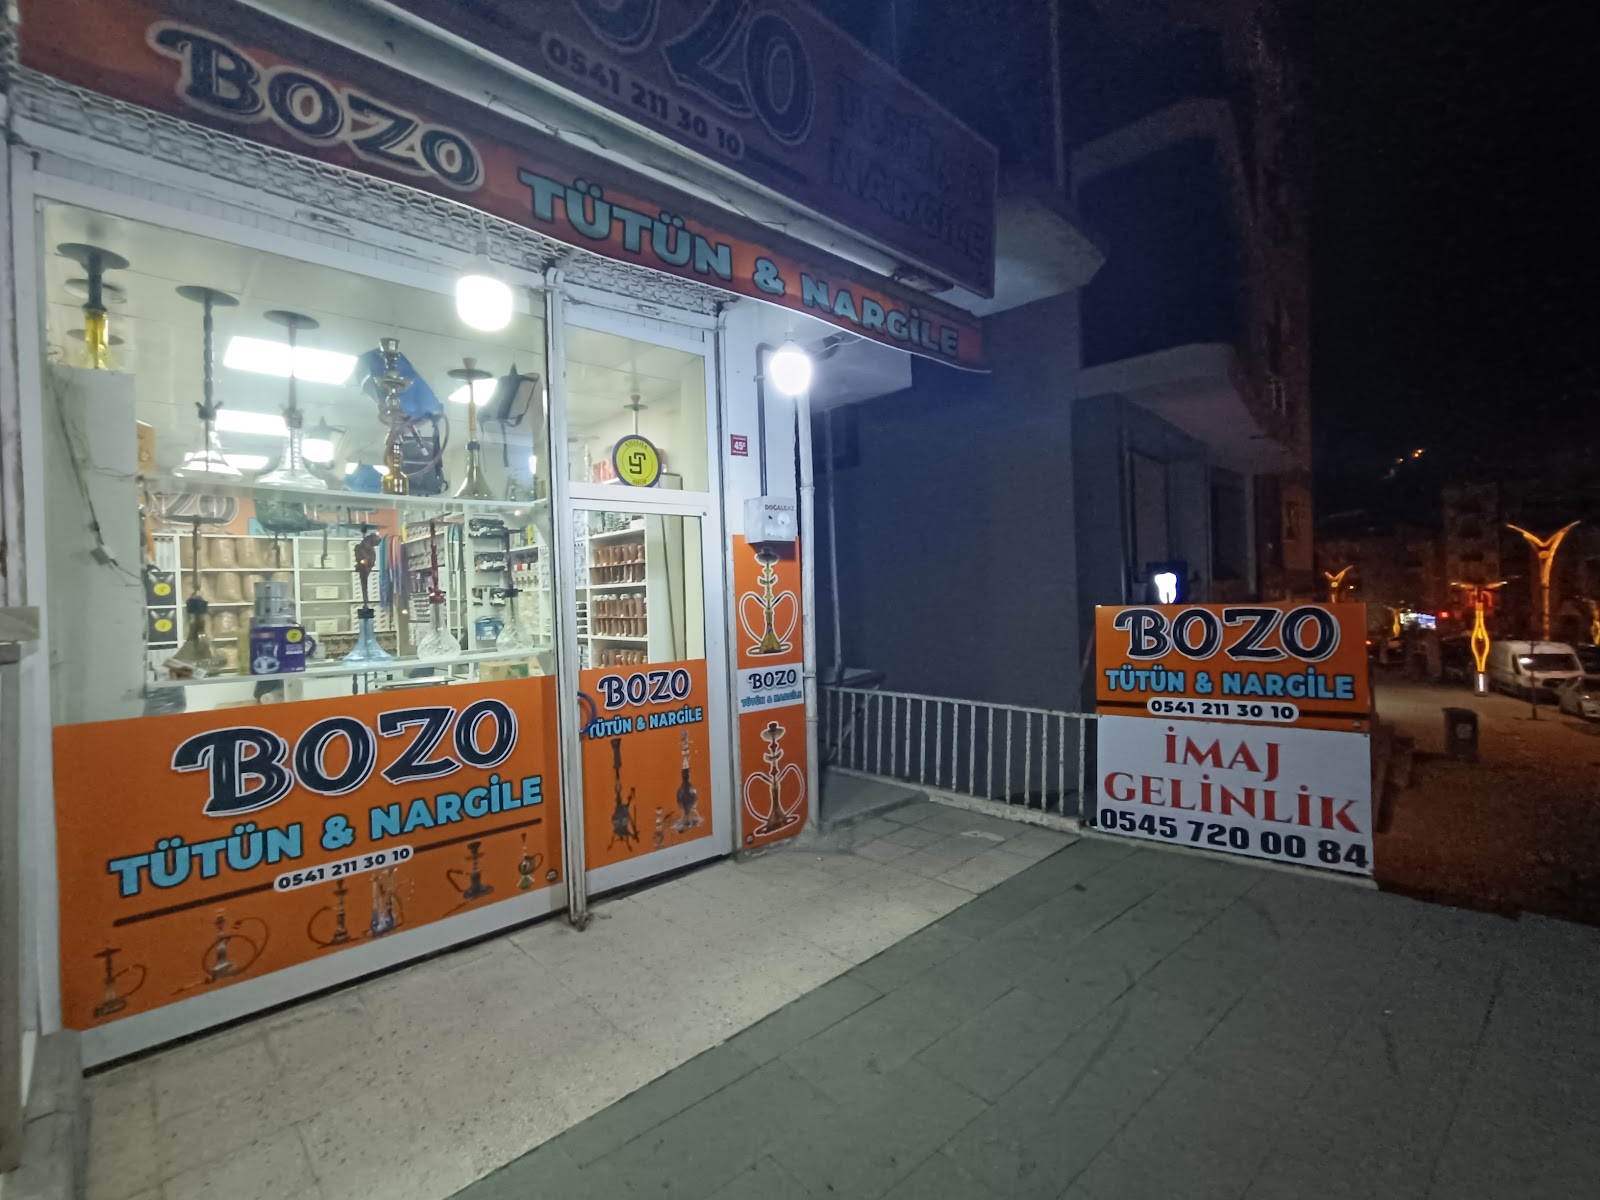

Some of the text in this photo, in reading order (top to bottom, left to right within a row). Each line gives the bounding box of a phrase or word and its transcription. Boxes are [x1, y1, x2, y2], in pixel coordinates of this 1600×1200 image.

[145, 21, 484, 191] BOZO
[546, 38, 741, 155] 0541 211 30 10
[518, 168, 959, 357] TÜTÜN & NARGİLE
[1113, 606, 1341, 662] BOZO
[597, 668, 692, 710] BOZO
[748, 669, 797, 690] BOZO
[1105, 664, 1355, 700] TÜTÜN & NARGİLE
[636, 716, 646, 731] &
[649, 705, 703, 729] NARGİLE
[1151, 700, 1294, 720] 0541 211 30 10
[170, 698, 518, 817] BOZO
[1164, 725, 1283, 783] İMAJ
[1104, 771, 1361, 833] GELİNLİK
[109, 774, 543, 896] TÜTÜN & NARGİLE
[1100, 808, 1369, 868] 0545 720 00 84
[278, 846, 411, 890] 0541 211 30 10
